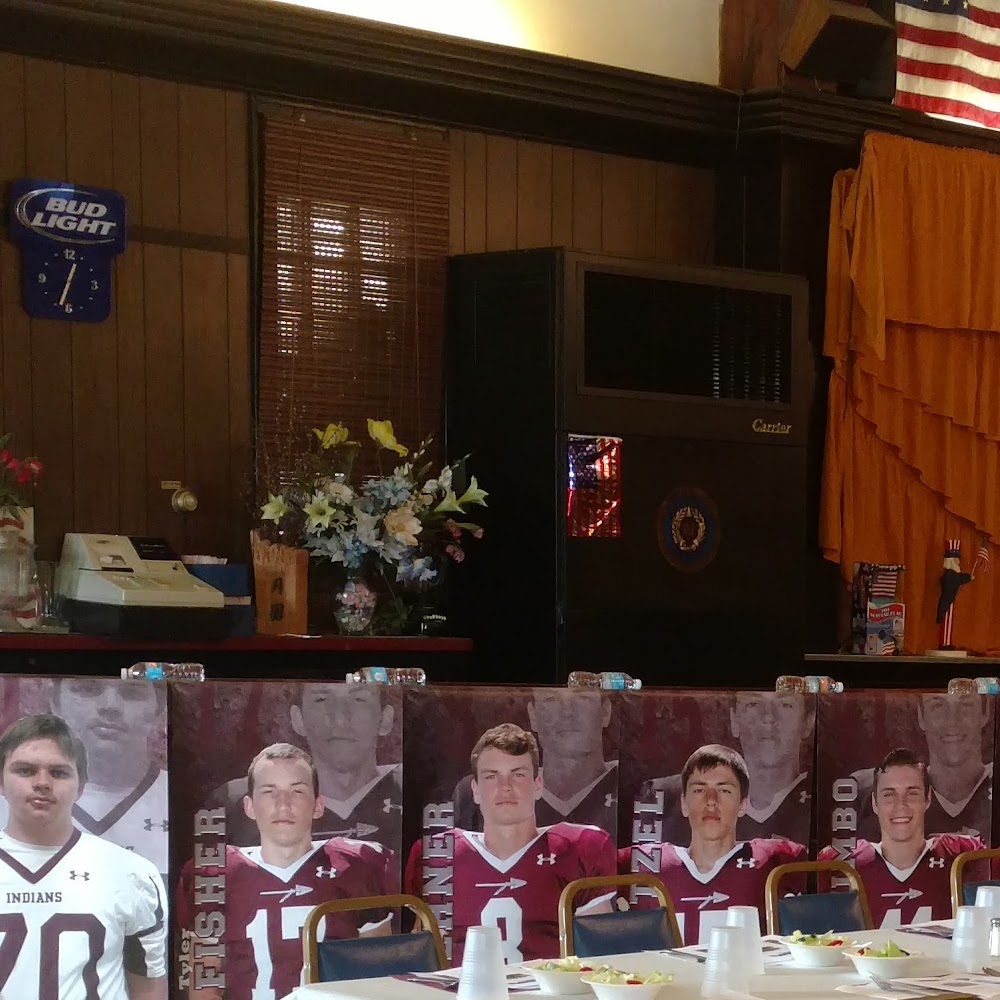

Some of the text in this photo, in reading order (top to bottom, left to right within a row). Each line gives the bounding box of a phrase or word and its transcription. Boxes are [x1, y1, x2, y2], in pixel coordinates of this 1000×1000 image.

[45, 197, 107, 218] BUD
[31, 212, 117, 236] LIGHT
[64, 248, 76, 260] 12
[38, 273, 47, 284] 9
[90, 280, 99, 291] 3
[65, 304, 73, 314] 6
[752, 418, 792, 434] Carrier
[6, 891, 63, 904] INDIANS
[194, 806, 226, 990] FISHER
[178, 928, 194, 990] Tyler
